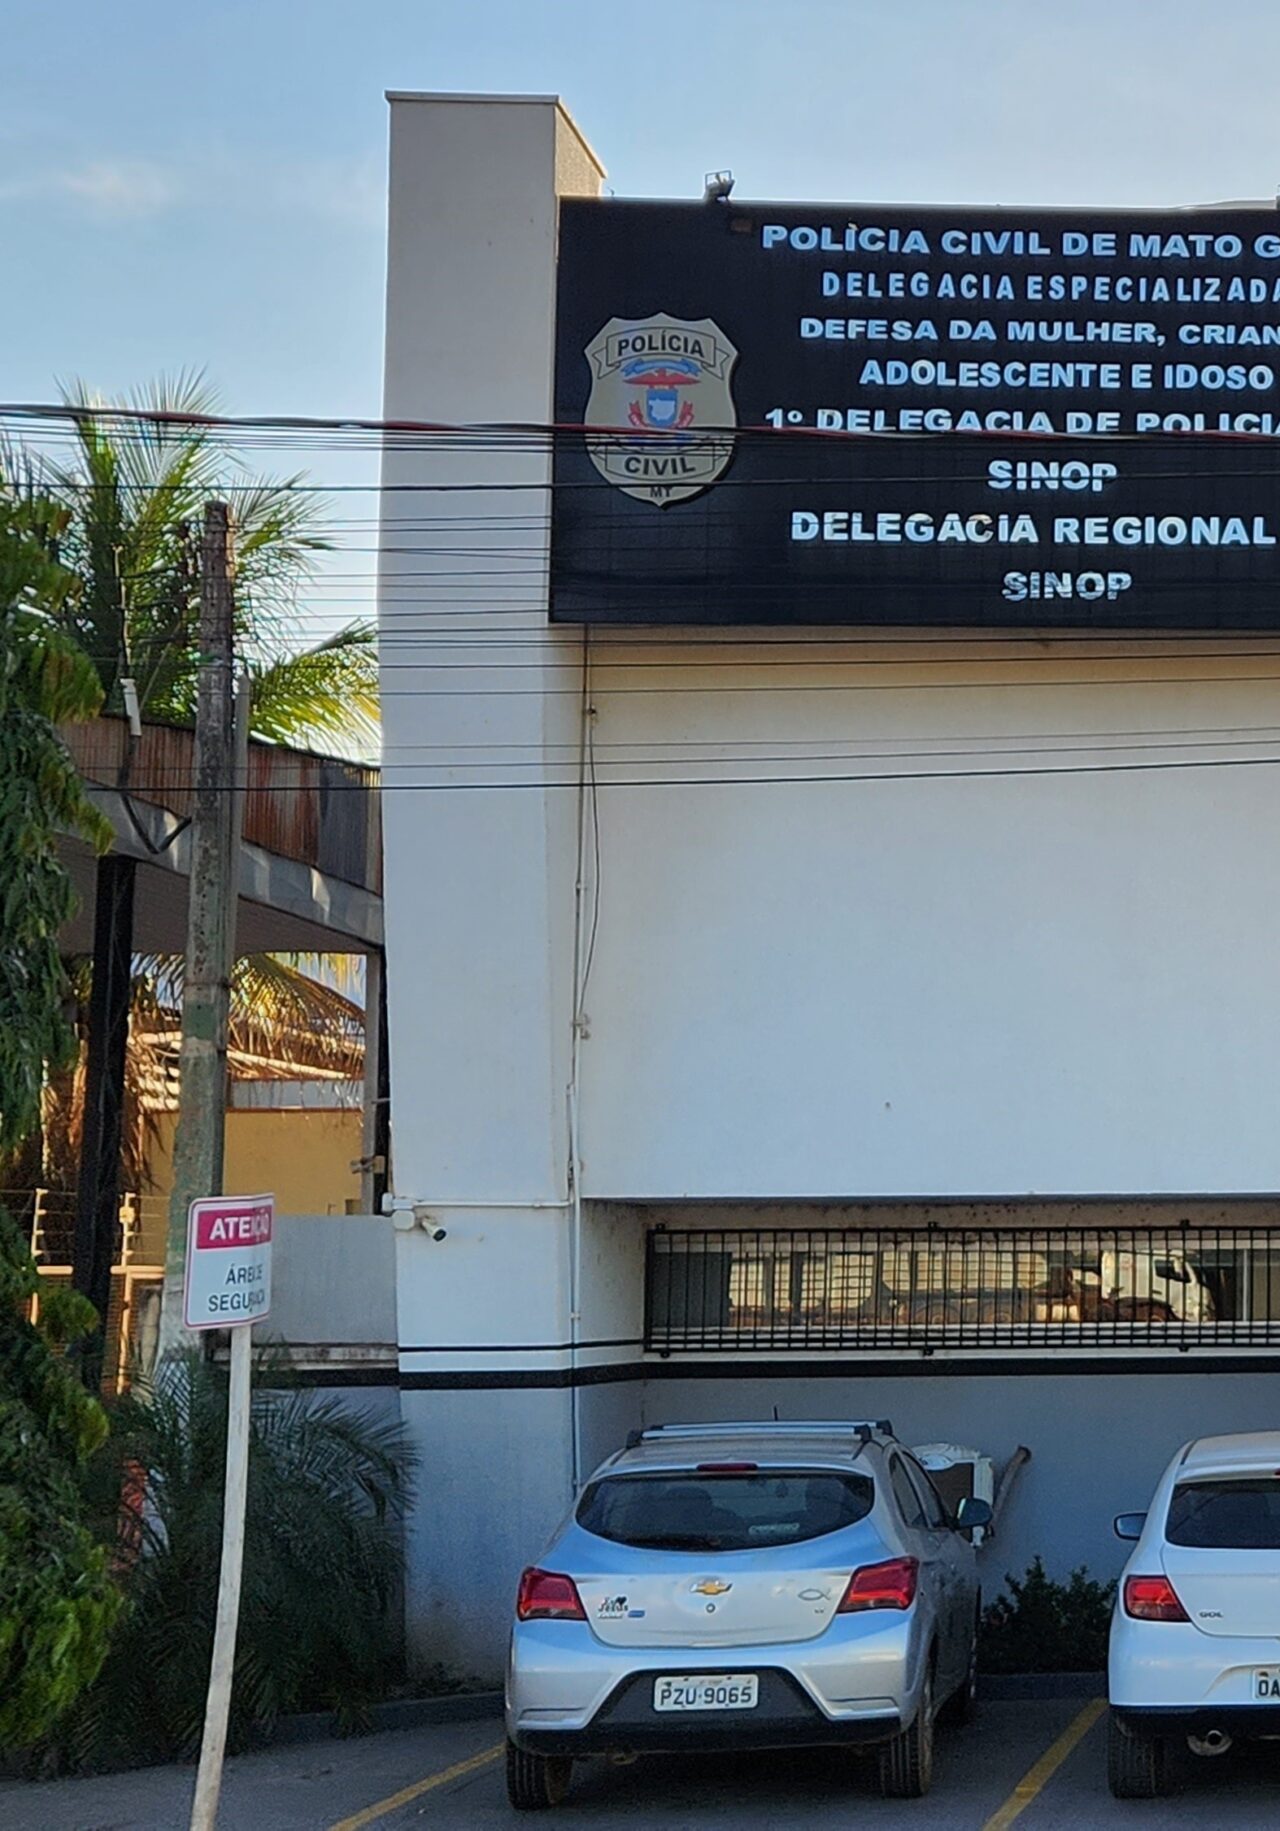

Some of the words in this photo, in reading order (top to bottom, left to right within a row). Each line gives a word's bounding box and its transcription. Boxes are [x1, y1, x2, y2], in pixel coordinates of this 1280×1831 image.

[941, 230, 1050, 255] CIVIL
[1063, 233, 1117, 256] DE
[1129, 234, 1243, 258] MATO
[823, 272, 1015, 300] DELEGACIA
[618, 330, 704, 356] POLÍCIA
[800, 318, 938, 340] DEFESA
[949, 320, 997, 341] DA
[1008, 321, 1166, 346] MULHER,
[859, 360, 1120, 389] ADOLESCENTE
[1131, 364, 1152, 388] E
[1164, 364, 1274, 390] IDOSO
[816, 408, 1054, 433] DELEGACIA
[1066, 411, 1121, 433] DE
[624, 457, 695, 476] CIVIL
[987, 460, 1118, 491] SINOP
[650, 486, 673, 498] MT
[791, 511, 1039, 543] DELEGACIA
[1053, 516, 1277, 546] REGIONAL
[1001, 571, 1132, 601] SINOP
